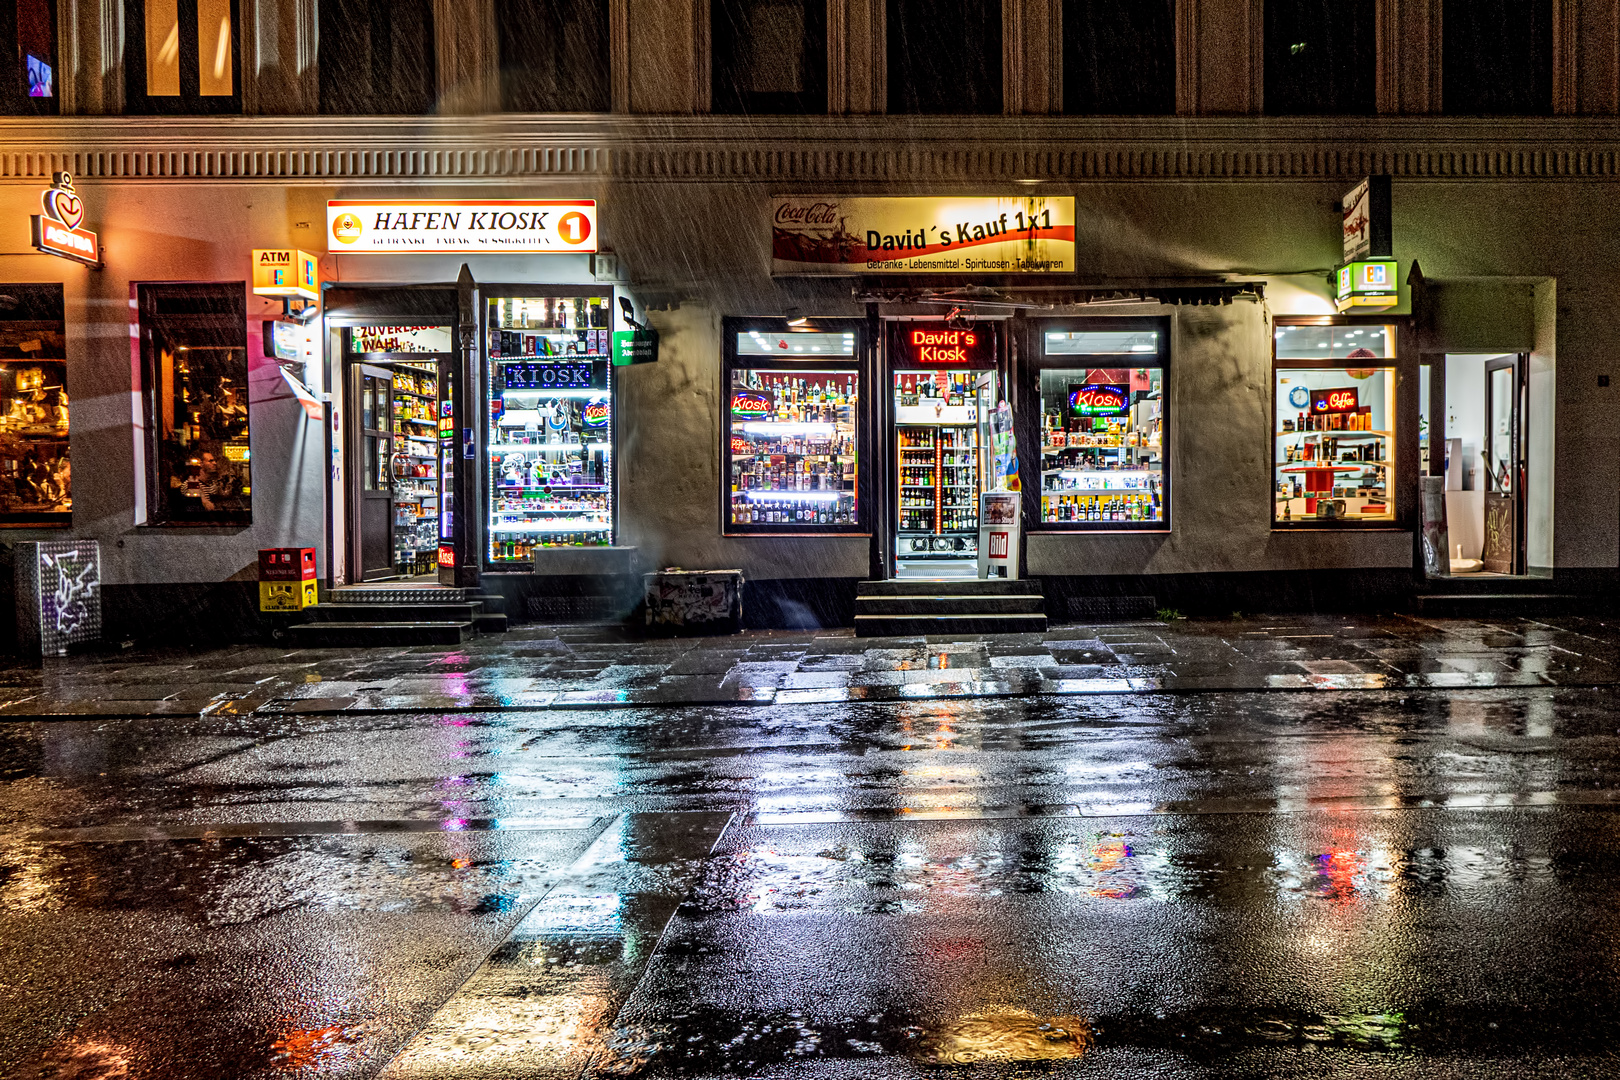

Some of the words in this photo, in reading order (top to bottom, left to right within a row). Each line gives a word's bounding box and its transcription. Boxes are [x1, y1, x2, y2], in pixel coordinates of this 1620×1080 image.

[373, 212, 461, 230] HAFEN
[468, 212, 549, 230] KIOSK
[566, 216, 581, 239] 1
[956, 213, 1008, 244] Kauf
[1015, 209, 1054, 233] 1x1
[46, 225, 94, 254] ASTRA
[260, 251, 290, 262] ATM
[909, 258, 960, 269] Lebensmittel
[965, 258, 1010, 271] Spirituosen
[1016, 258, 1064, 269] Tabakwaren
[362, 337, 401, 352] WAHL
[920, 346, 967, 361] Kiosk
[512, 369, 586, 383] KIOSK
[732, 396, 768, 410] Kiosk
[1329, 392, 1355, 409] Coffee
[585, 405, 608, 418] Kiosk
[990, 534, 1007, 555] Bild
[438, 547, 454, 565] Kiosk
